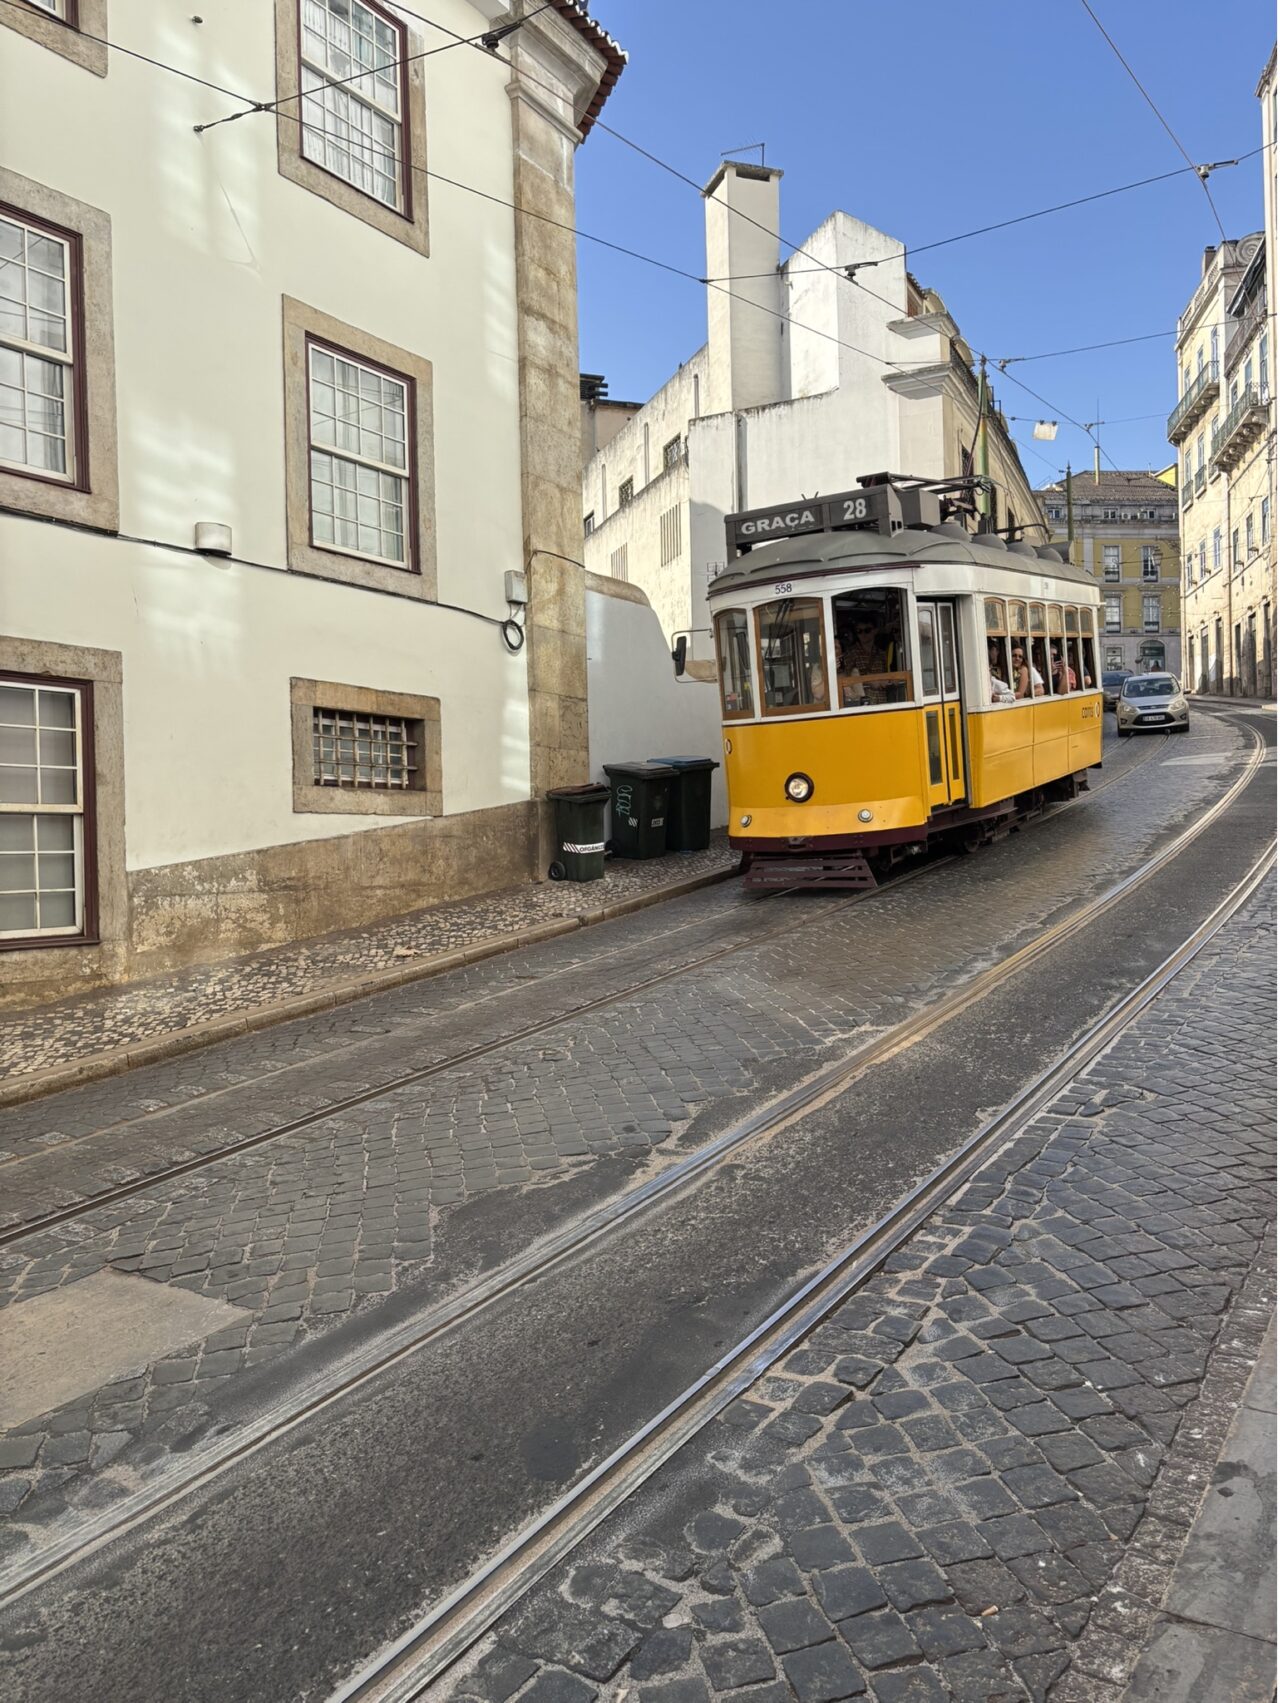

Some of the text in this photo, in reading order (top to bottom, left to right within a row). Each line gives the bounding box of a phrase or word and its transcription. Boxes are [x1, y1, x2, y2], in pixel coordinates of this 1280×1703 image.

[843, 498, 867, 521] 28
[741, 510, 815, 535] GRAÇA
[774, 583, 793, 595] 558
